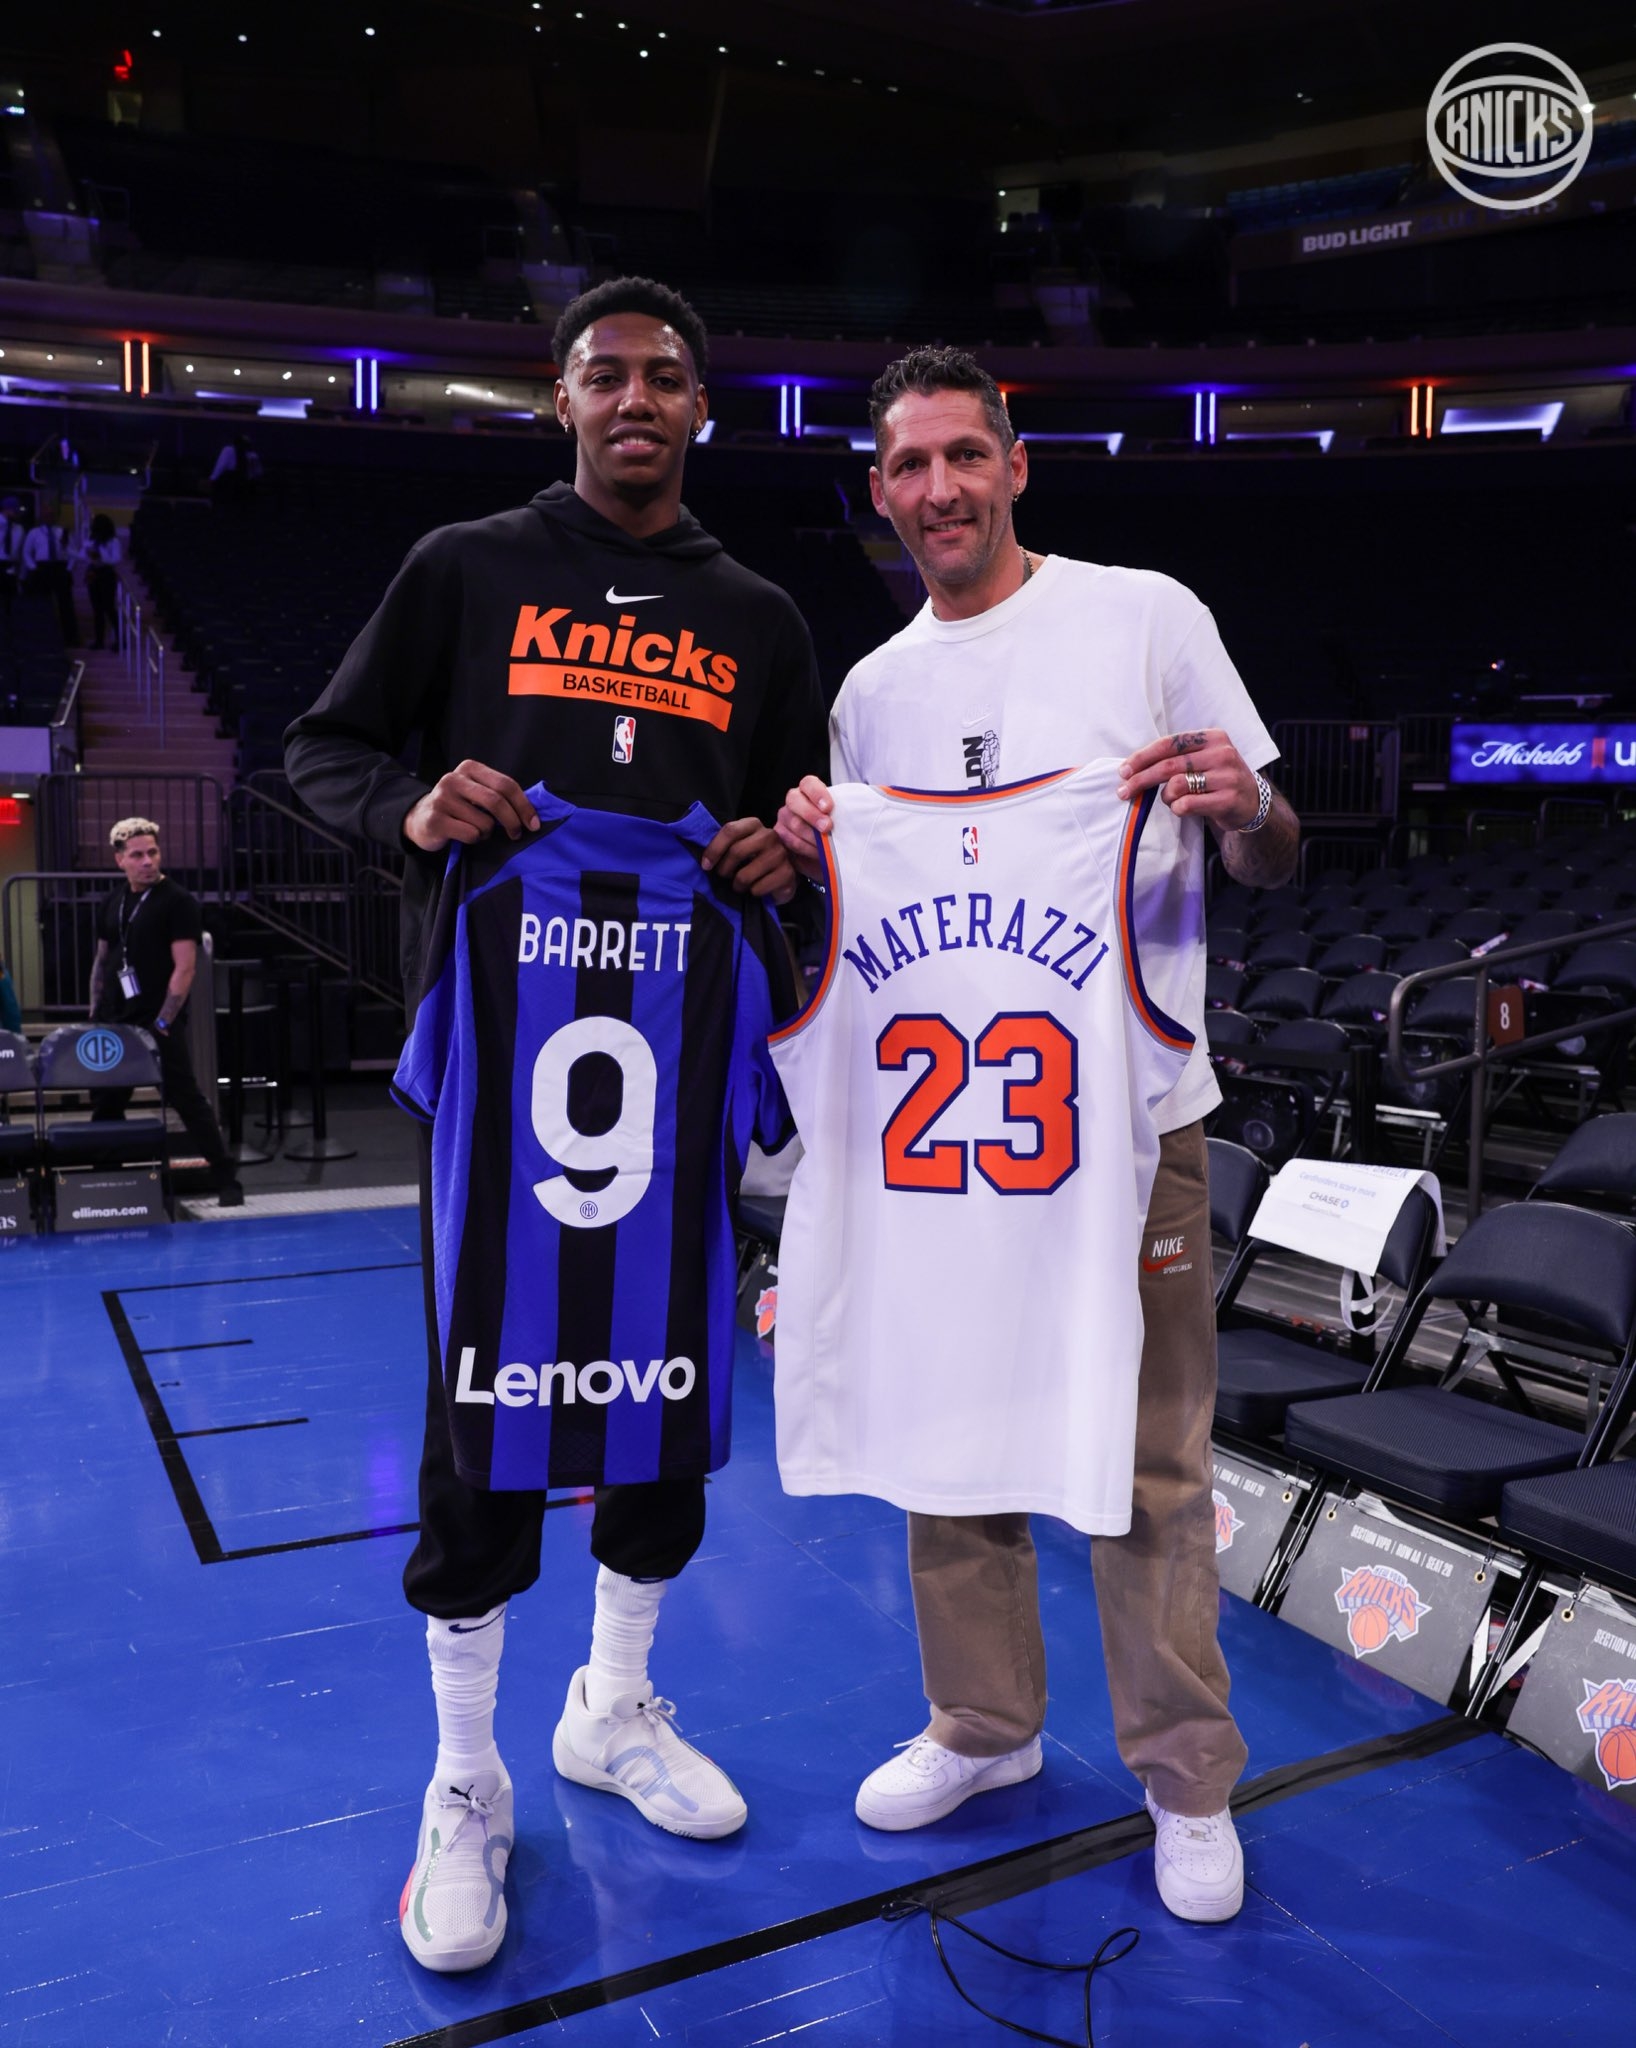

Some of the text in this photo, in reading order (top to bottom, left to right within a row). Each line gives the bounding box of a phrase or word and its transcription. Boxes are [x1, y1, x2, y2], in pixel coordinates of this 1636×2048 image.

[1302, 231, 1347, 253] BUD
[1350, 221, 1412, 246] LIGHT
[510, 604, 738, 694] Knicks
[563, 673, 691, 710] BASKETBALL
[1471, 741, 1587, 768] Michelob
[518, 913, 692, 972] BARRETT
[843, 893, 1110, 994] MATERAZZI
[1500, 1002, 1510, 1030] 8
[531, 1016, 658, 1229] 9
[876, 1011, 1080, 1196] 23
[72, 1205, 148, 1219] elliman.com
[1309, 1191, 1341, 1207] CHASE
[1152, 1236, 1185, 1258] NIKE
[455, 1347, 696, 1408] Lenovo
[1350, 1524, 1378, 1546] SECTION
[1395, 1543, 1415, 1560] ROW
[1409, 1549, 1422, 1564] AA
[1425, 1556, 1444, 1574] SEAT
[1337, 1568, 1417, 1633] KNICKS
[1594, 1628, 1629, 1655] SECTION
